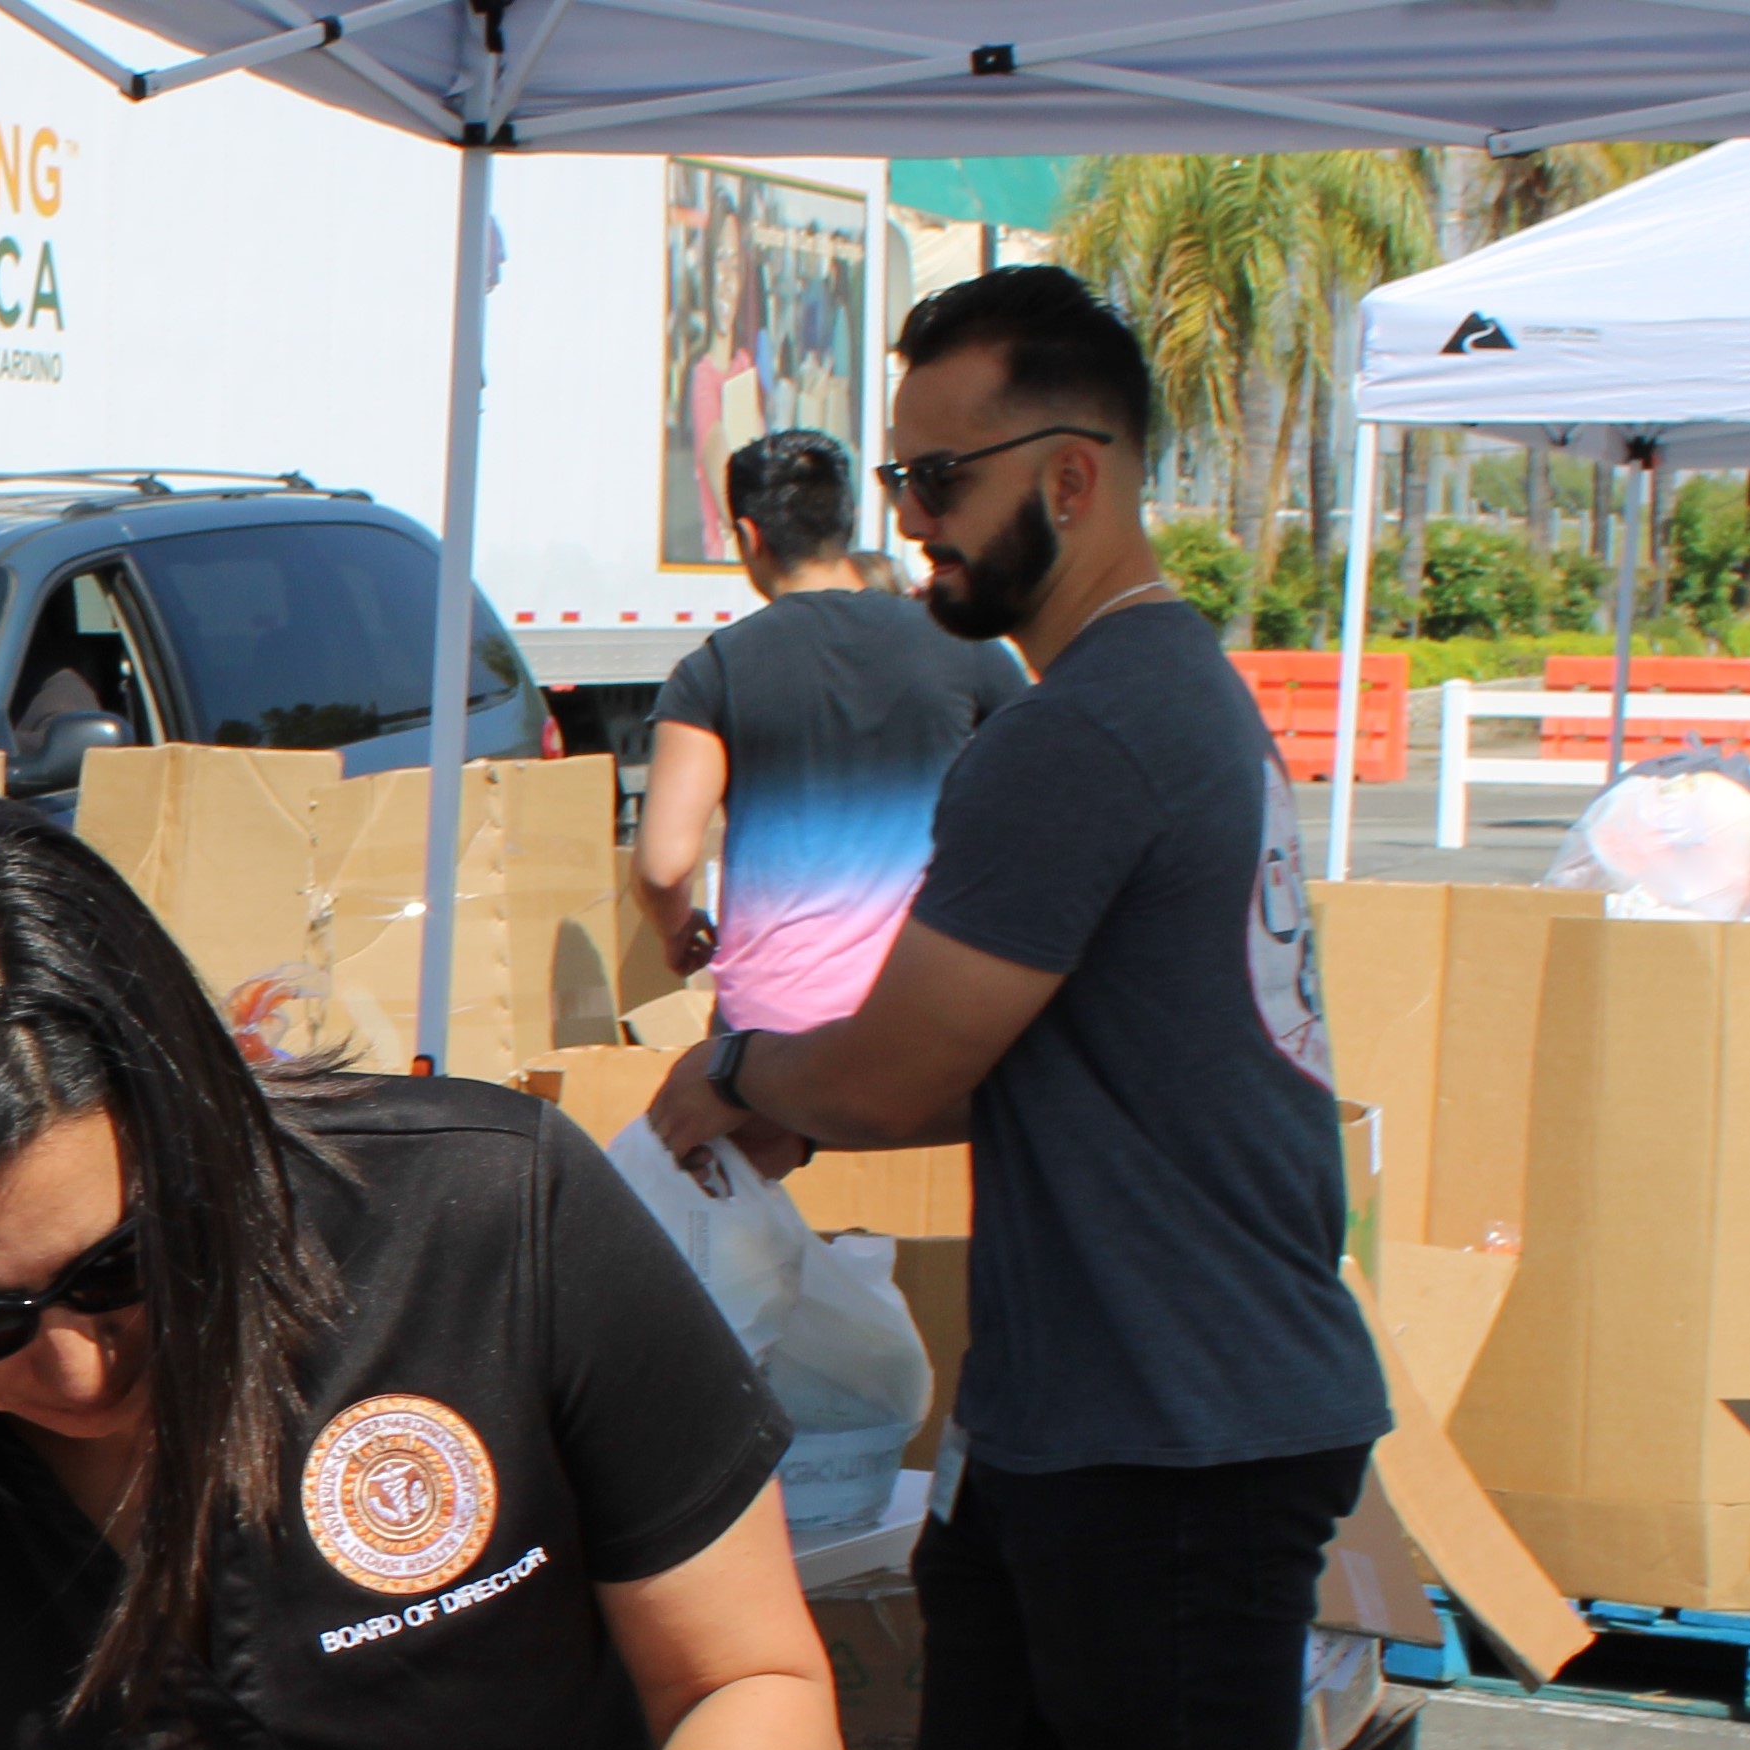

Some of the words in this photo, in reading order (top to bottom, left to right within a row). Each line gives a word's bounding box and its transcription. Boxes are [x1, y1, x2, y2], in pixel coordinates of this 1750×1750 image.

[319, 1613, 402, 1654] BOARD
[403, 1599, 440, 1628] OF
[439, 1546, 548, 1615] DIRECTOR
